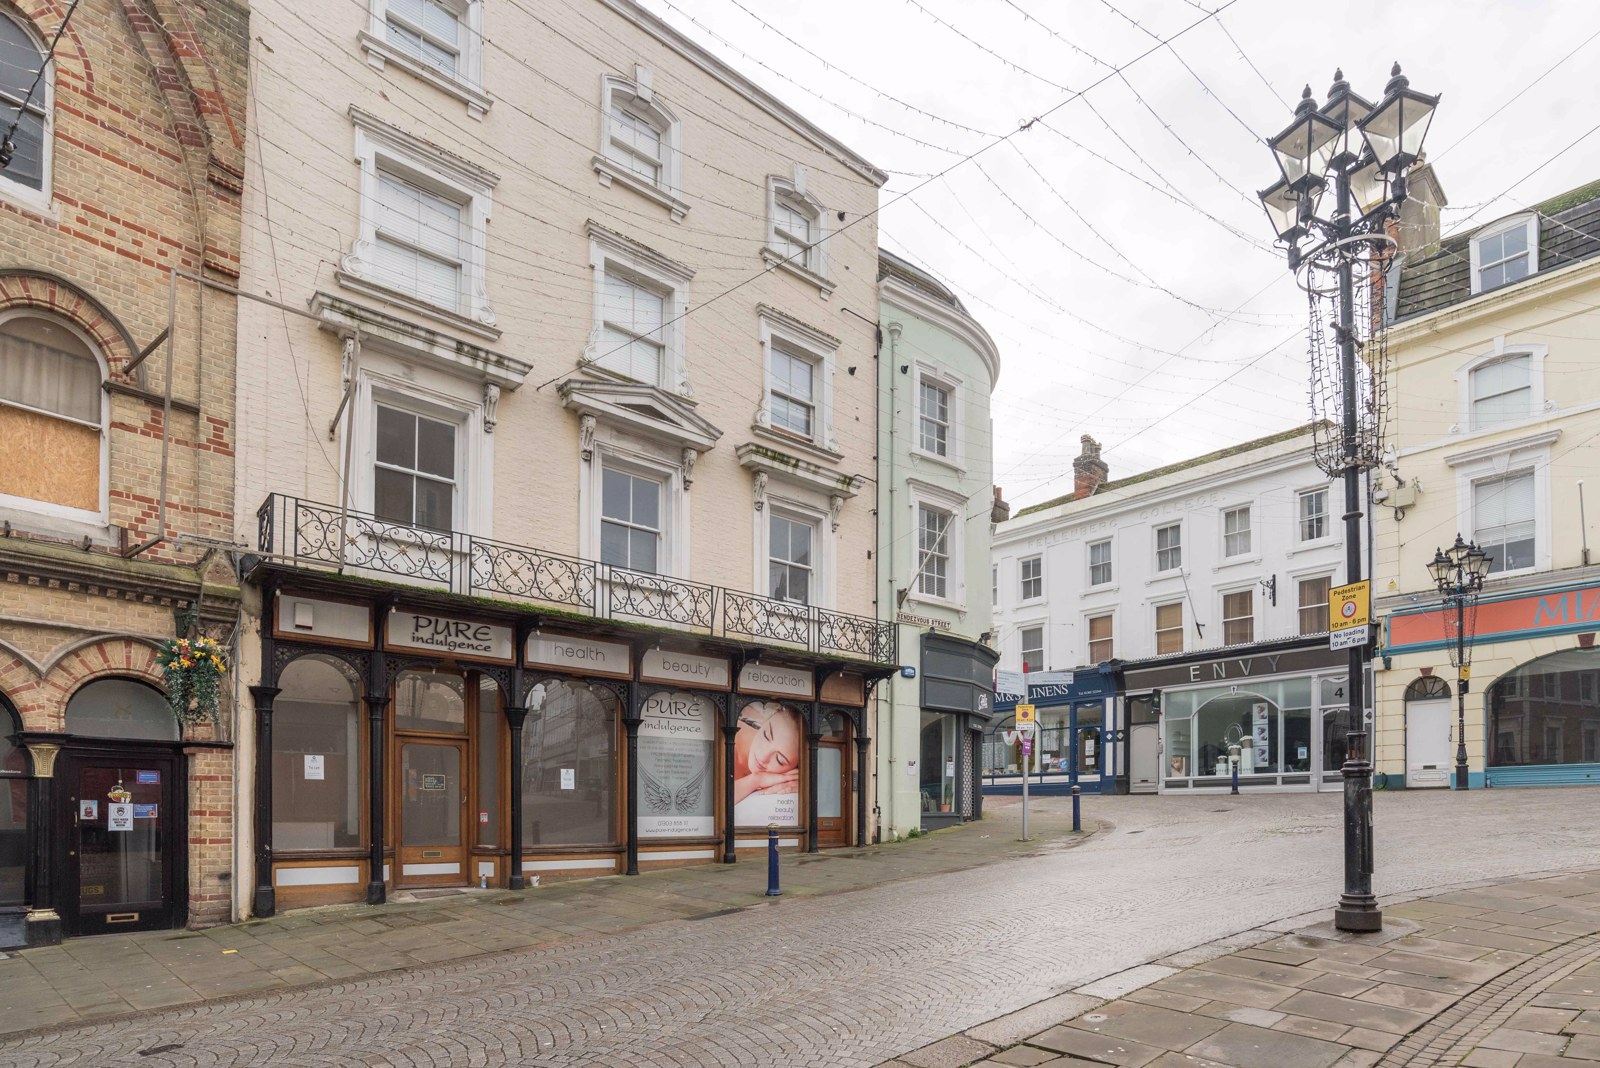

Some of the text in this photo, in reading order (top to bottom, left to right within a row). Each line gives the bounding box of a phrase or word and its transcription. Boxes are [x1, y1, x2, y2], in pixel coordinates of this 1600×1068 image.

[1334, 585, 1365, 596] Pedestrian
[412, 615, 492, 641] PURE
[896, 613, 951, 628] RENDEZVOUS STREET
[411, 632, 492, 652] indulgence
[1343, 629, 1364, 637] loading
[554, 642, 606, 661] health
[662, 658, 711, 678] beauty
[1190, 654, 1281, 682] ENVY
[747, 670, 805, 688] relaxation
[1334, 687, 1344, 698] 4
[645, 698, 702, 717] PURE
[643, 720, 702, 734] indulgence
